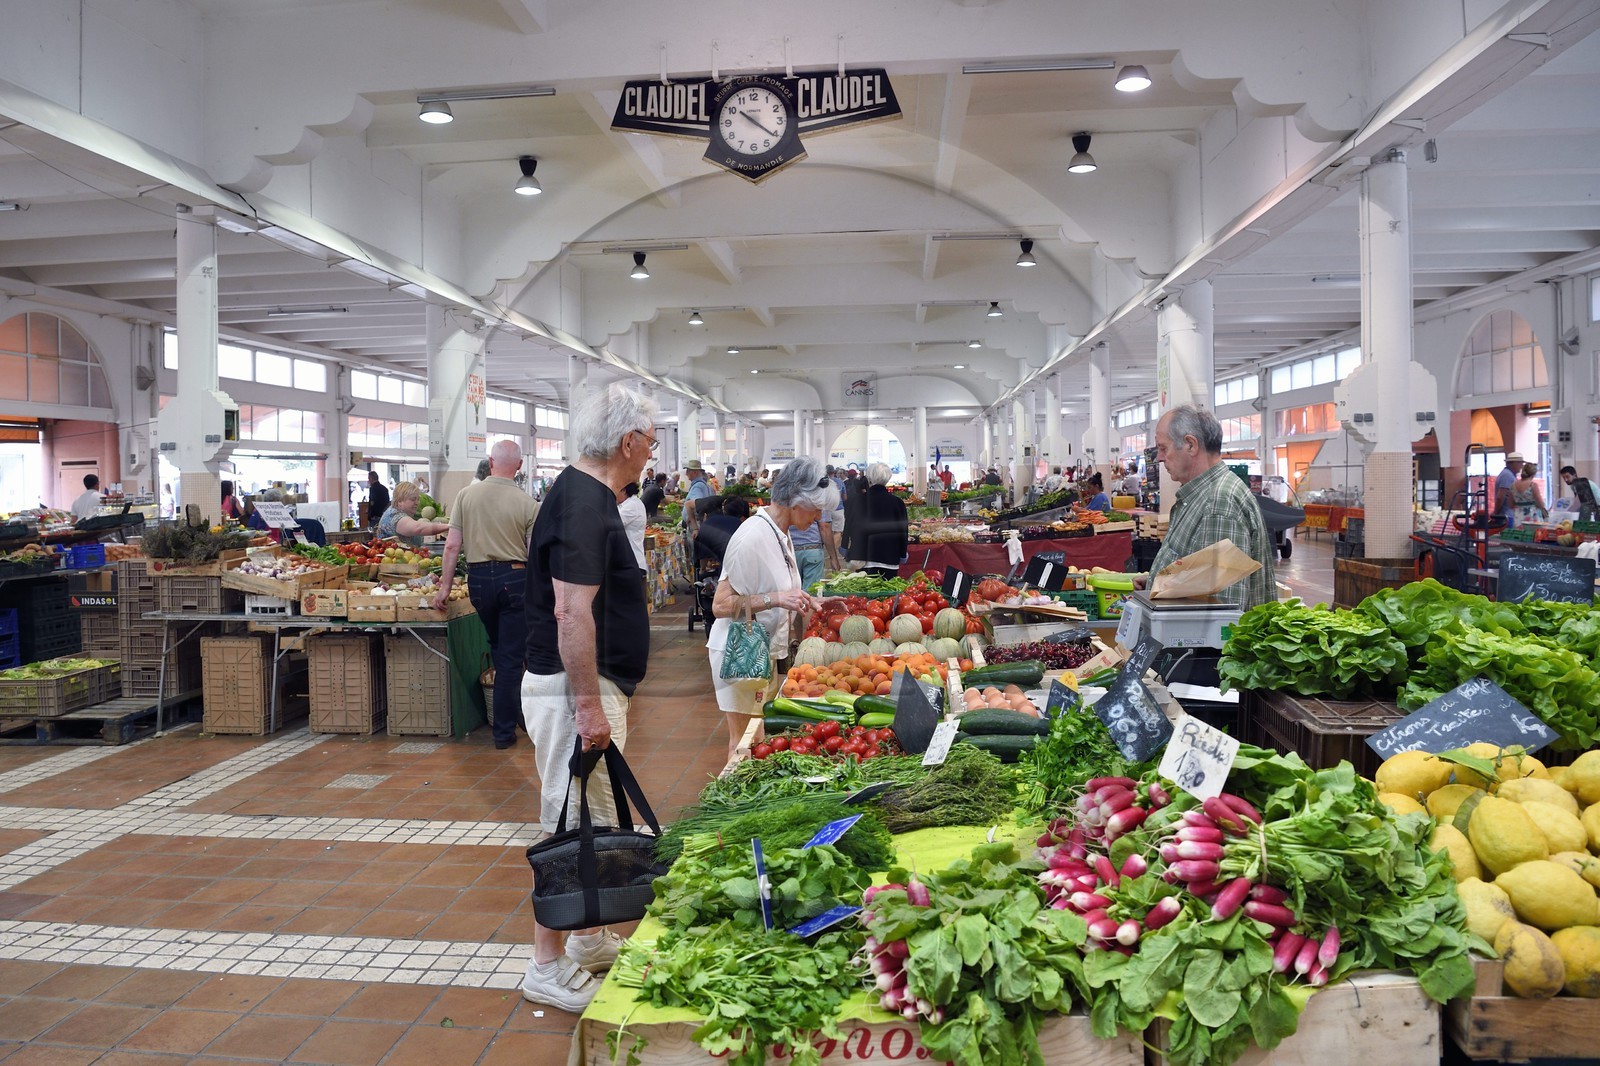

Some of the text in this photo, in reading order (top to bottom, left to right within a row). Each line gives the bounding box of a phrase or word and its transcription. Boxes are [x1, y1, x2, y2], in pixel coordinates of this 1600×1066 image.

[762, 76, 793, 99] FROMAGE
[738, 96, 746, 105] 11
[749, 92, 759, 102] 12
[765, 95, 769, 104] 1
[797, 75, 887, 118] CLAUDEL
[625, 83, 710, 121] CLAUDEL
[728, 106, 737, 115] 10
[772, 104, 780, 113] 2
[724, 119, 732, 127] 9
[776, 117, 784, 125] 3
[728, 131, 735, 140] 8
[738, 140, 745, 148] 7
[750, 143, 758, 151] 6
[763, 139, 770, 148] 5
[725, 155, 784, 171] DE NORMANDIE
[845, 388, 874, 396] CANNES
